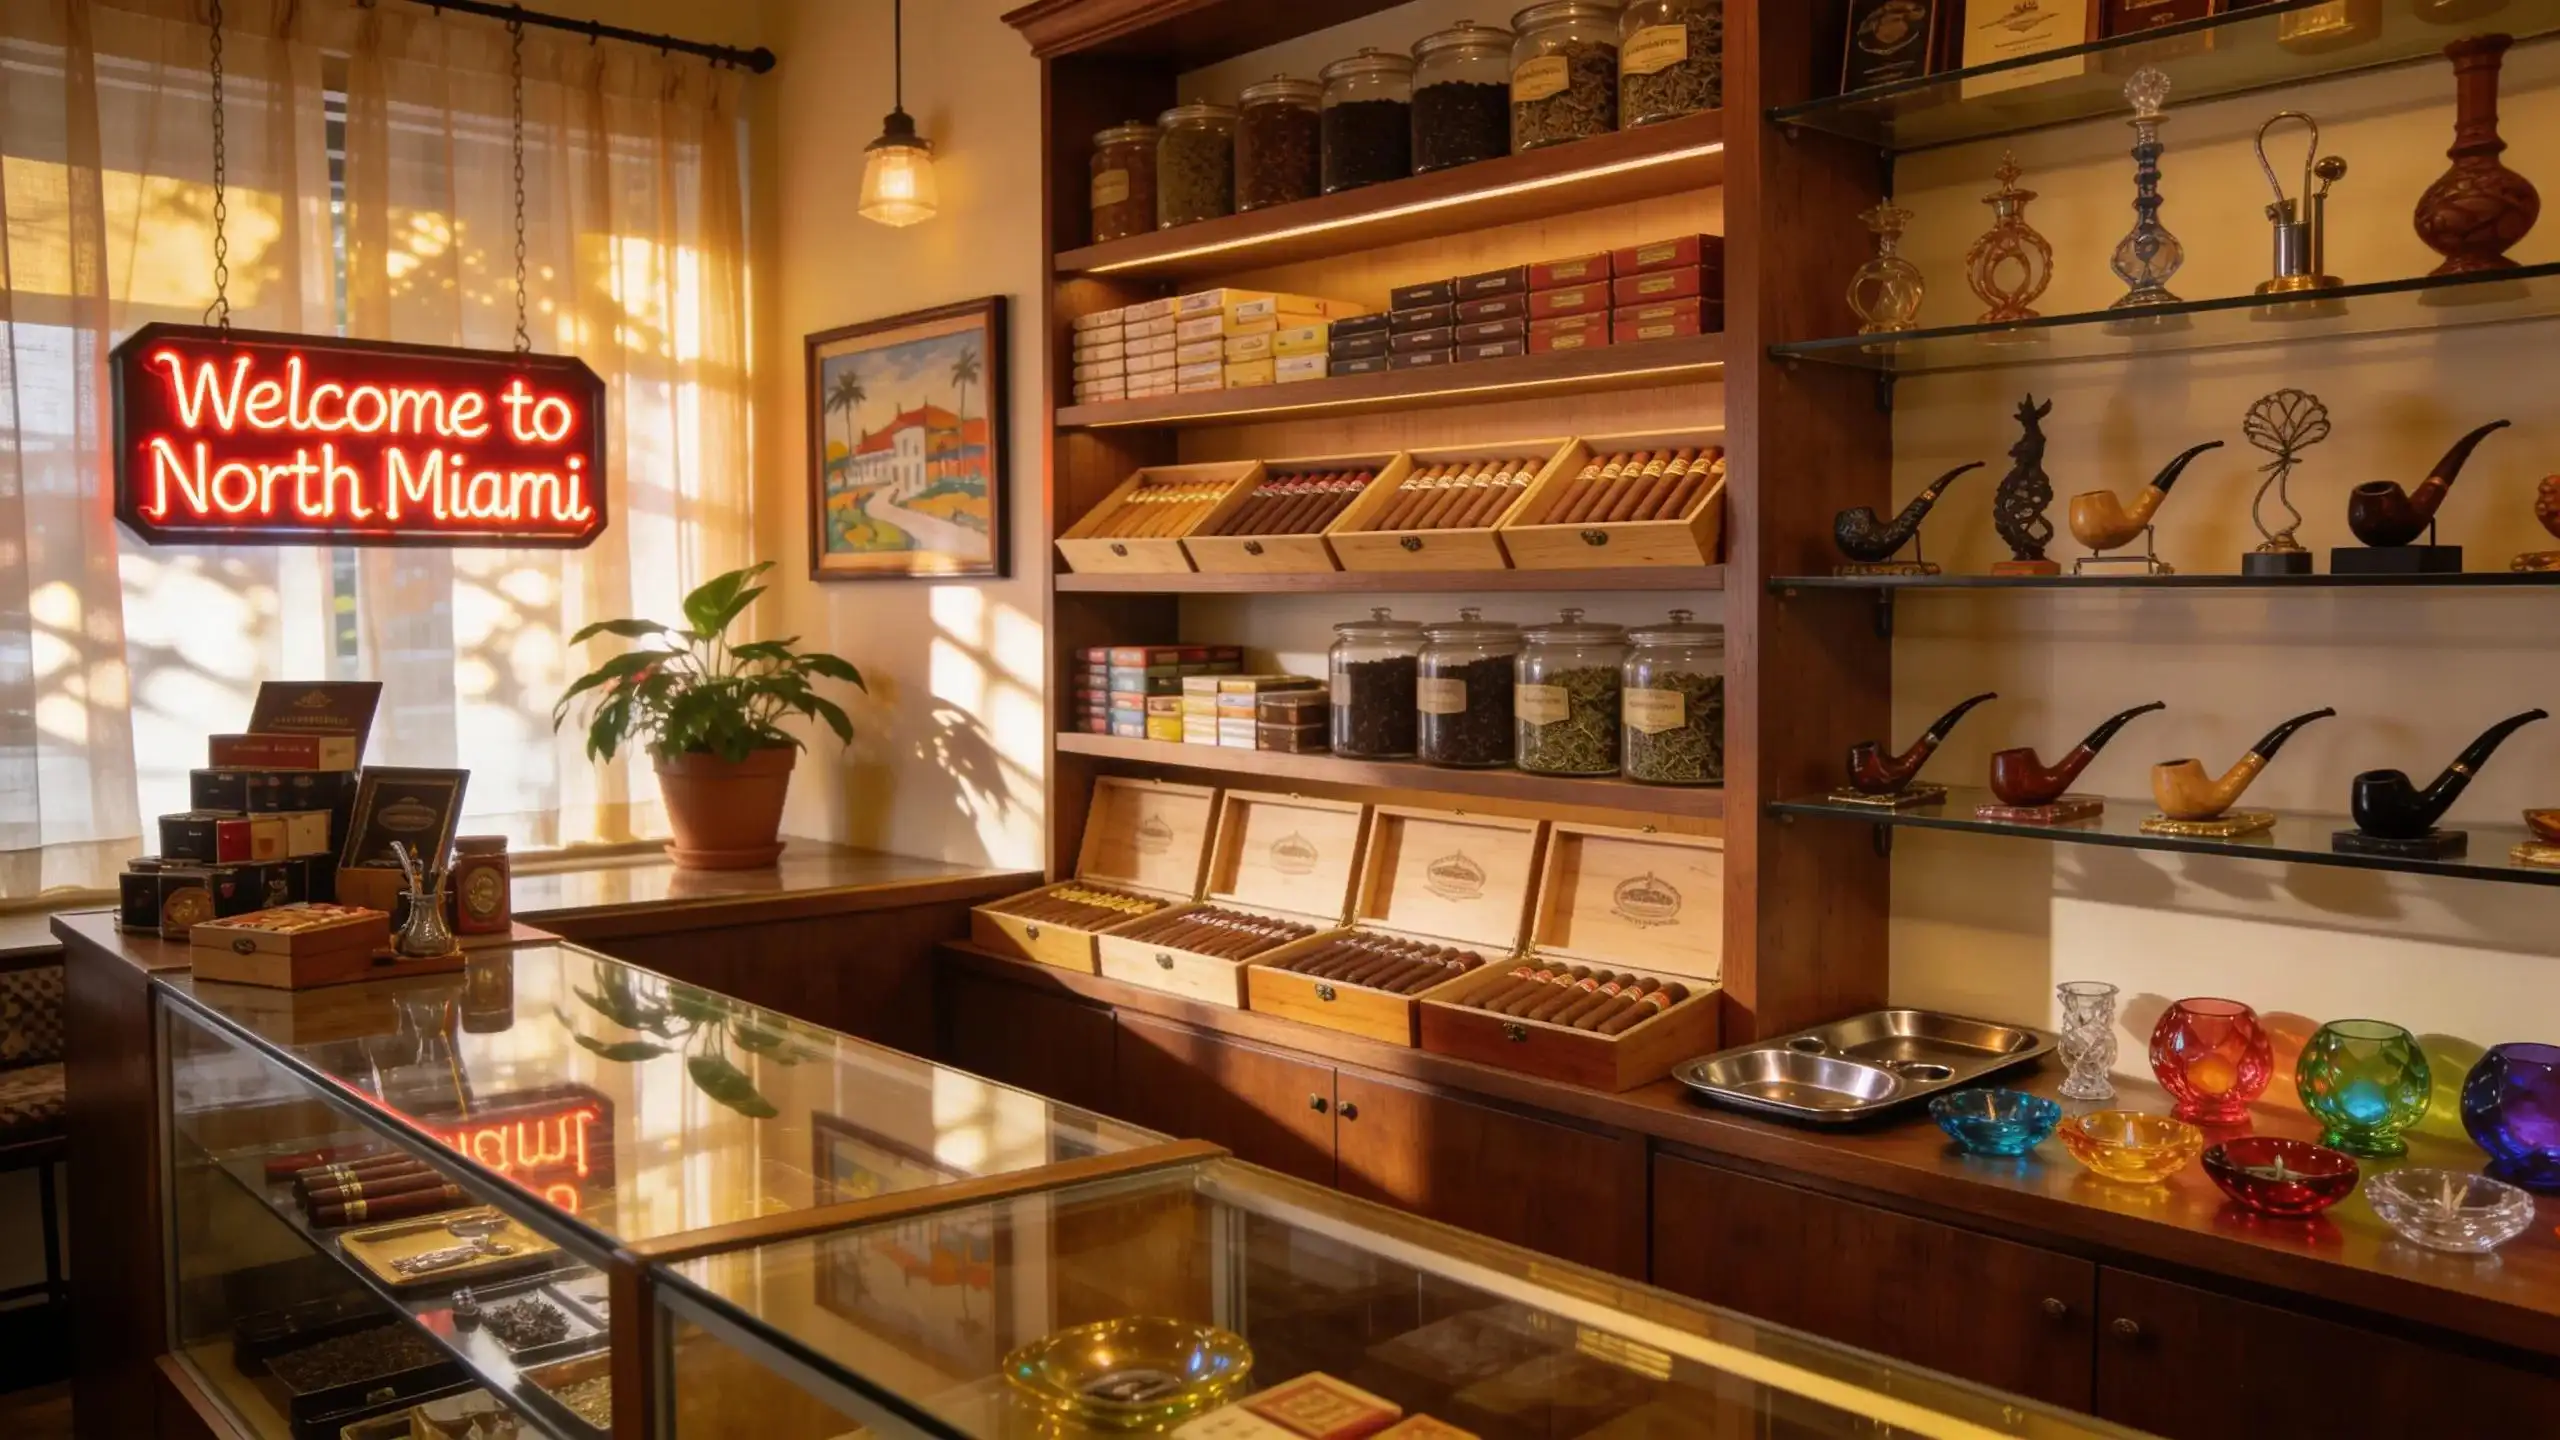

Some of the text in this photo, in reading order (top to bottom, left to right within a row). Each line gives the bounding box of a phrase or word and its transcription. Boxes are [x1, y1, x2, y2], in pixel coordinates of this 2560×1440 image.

[153, 351, 573, 442] Welcome to
[148, 437, 592, 520] North Miami
